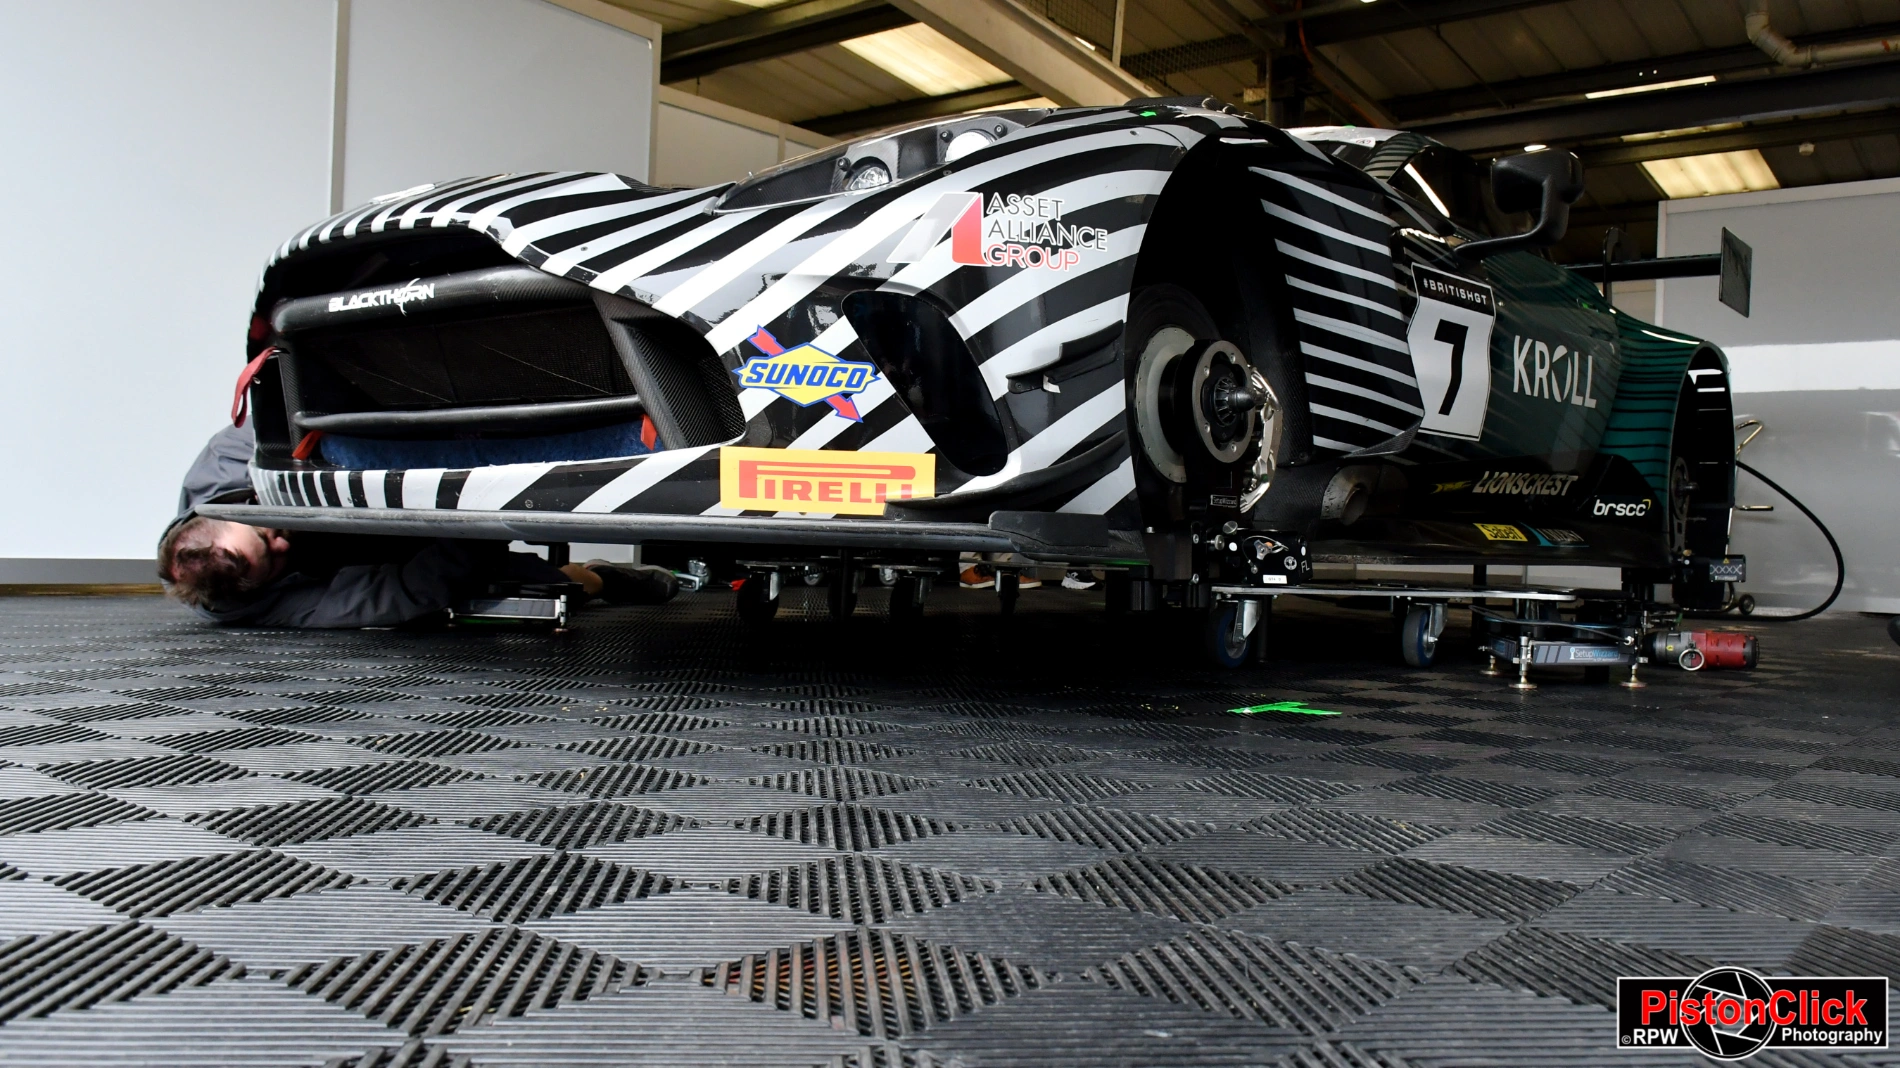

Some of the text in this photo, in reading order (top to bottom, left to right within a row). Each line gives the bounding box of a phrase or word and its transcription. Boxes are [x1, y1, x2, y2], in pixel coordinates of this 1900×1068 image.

[987, 193, 1064, 220] ASSET
[987, 218, 1107, 251] ALLIANCE
[987, 244, 1080, 271] GROUP
[328, 278, 436, 314] BLACKTHORN
[1423, 278, 1487, 305] #BRITISHGT
[745, 362, 868, 389] SUNOCO
[1434, 318, 1469, 416] 7
[1513, 335, 1597, 409] KROLL
[738, 459, 916, 504] PIRELLI
[1472, 471, 1579, 496] LIONSCREST
[1593, 499, 1648, 517] brscc
